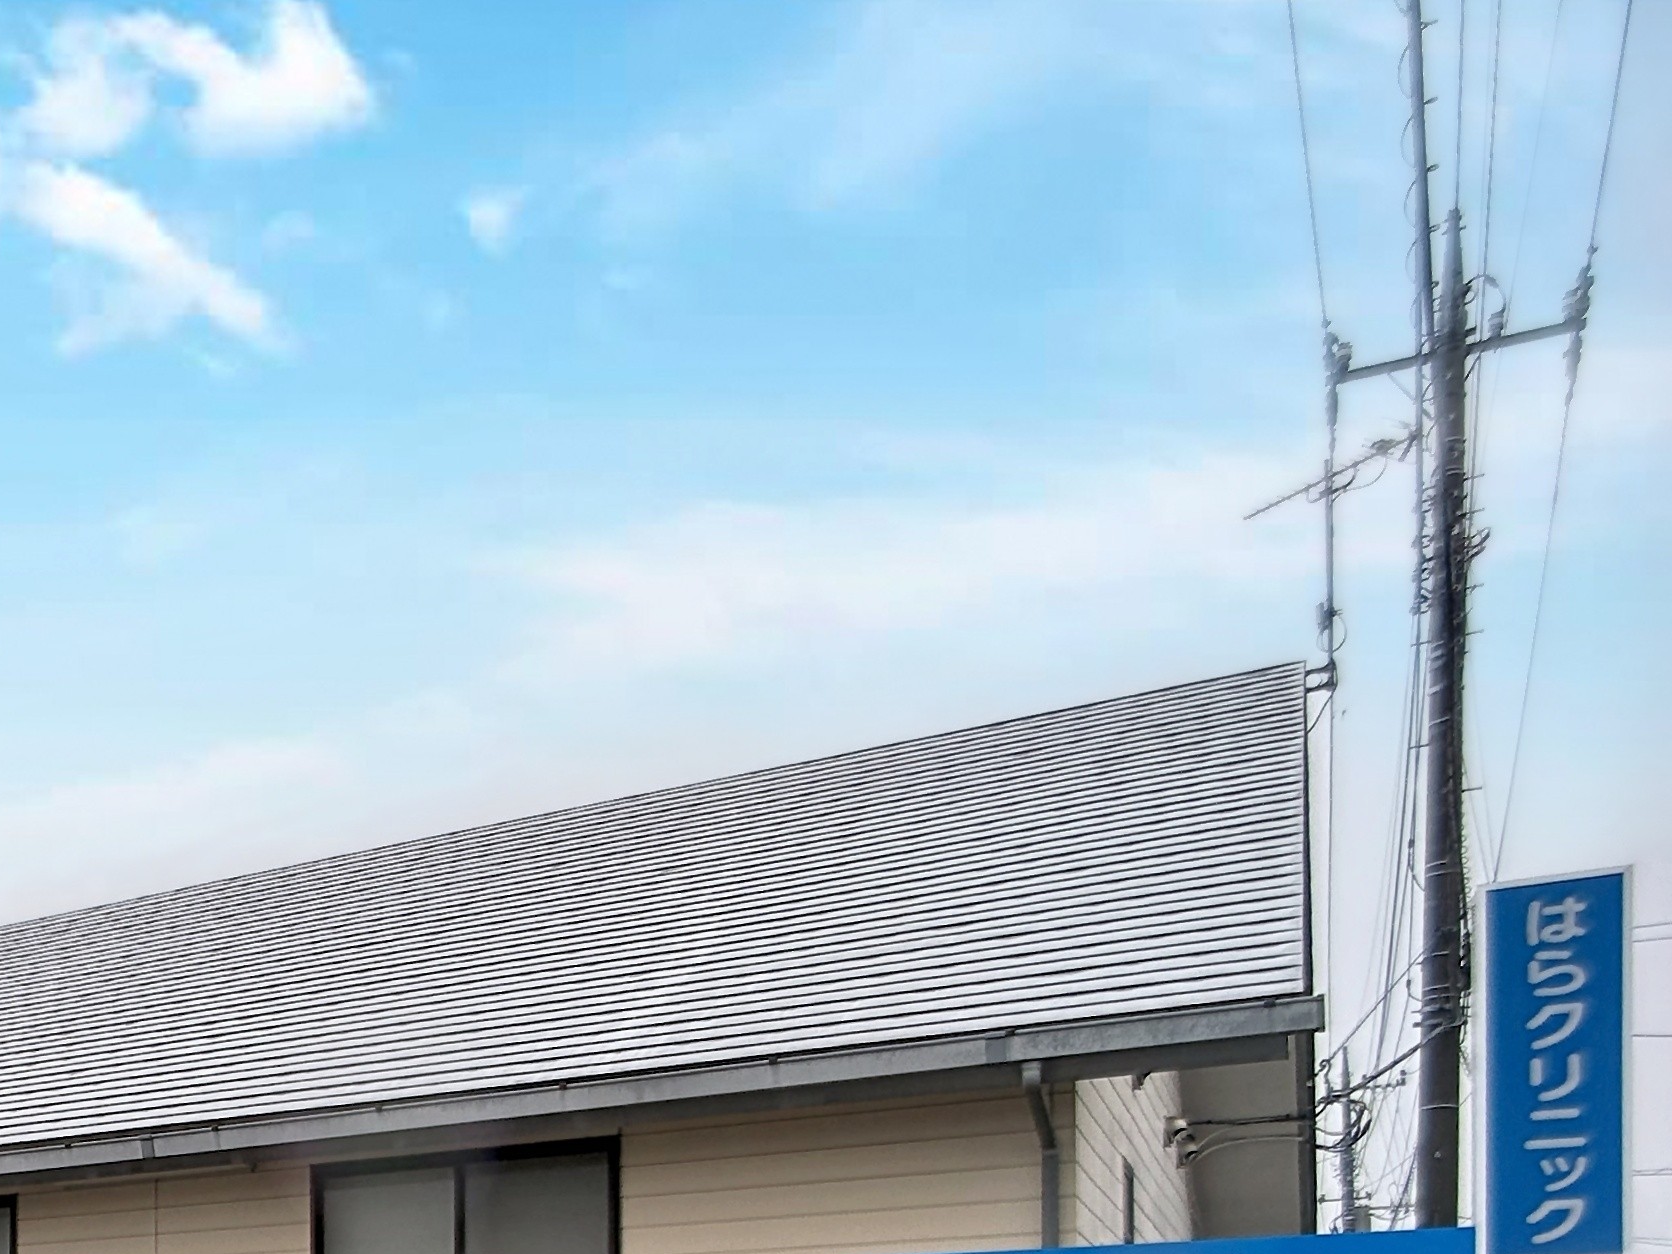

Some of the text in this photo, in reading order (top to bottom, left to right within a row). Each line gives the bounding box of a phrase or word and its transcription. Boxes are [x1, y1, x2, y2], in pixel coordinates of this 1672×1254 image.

[1525, 897, 1587, 1244] はらクリニック
